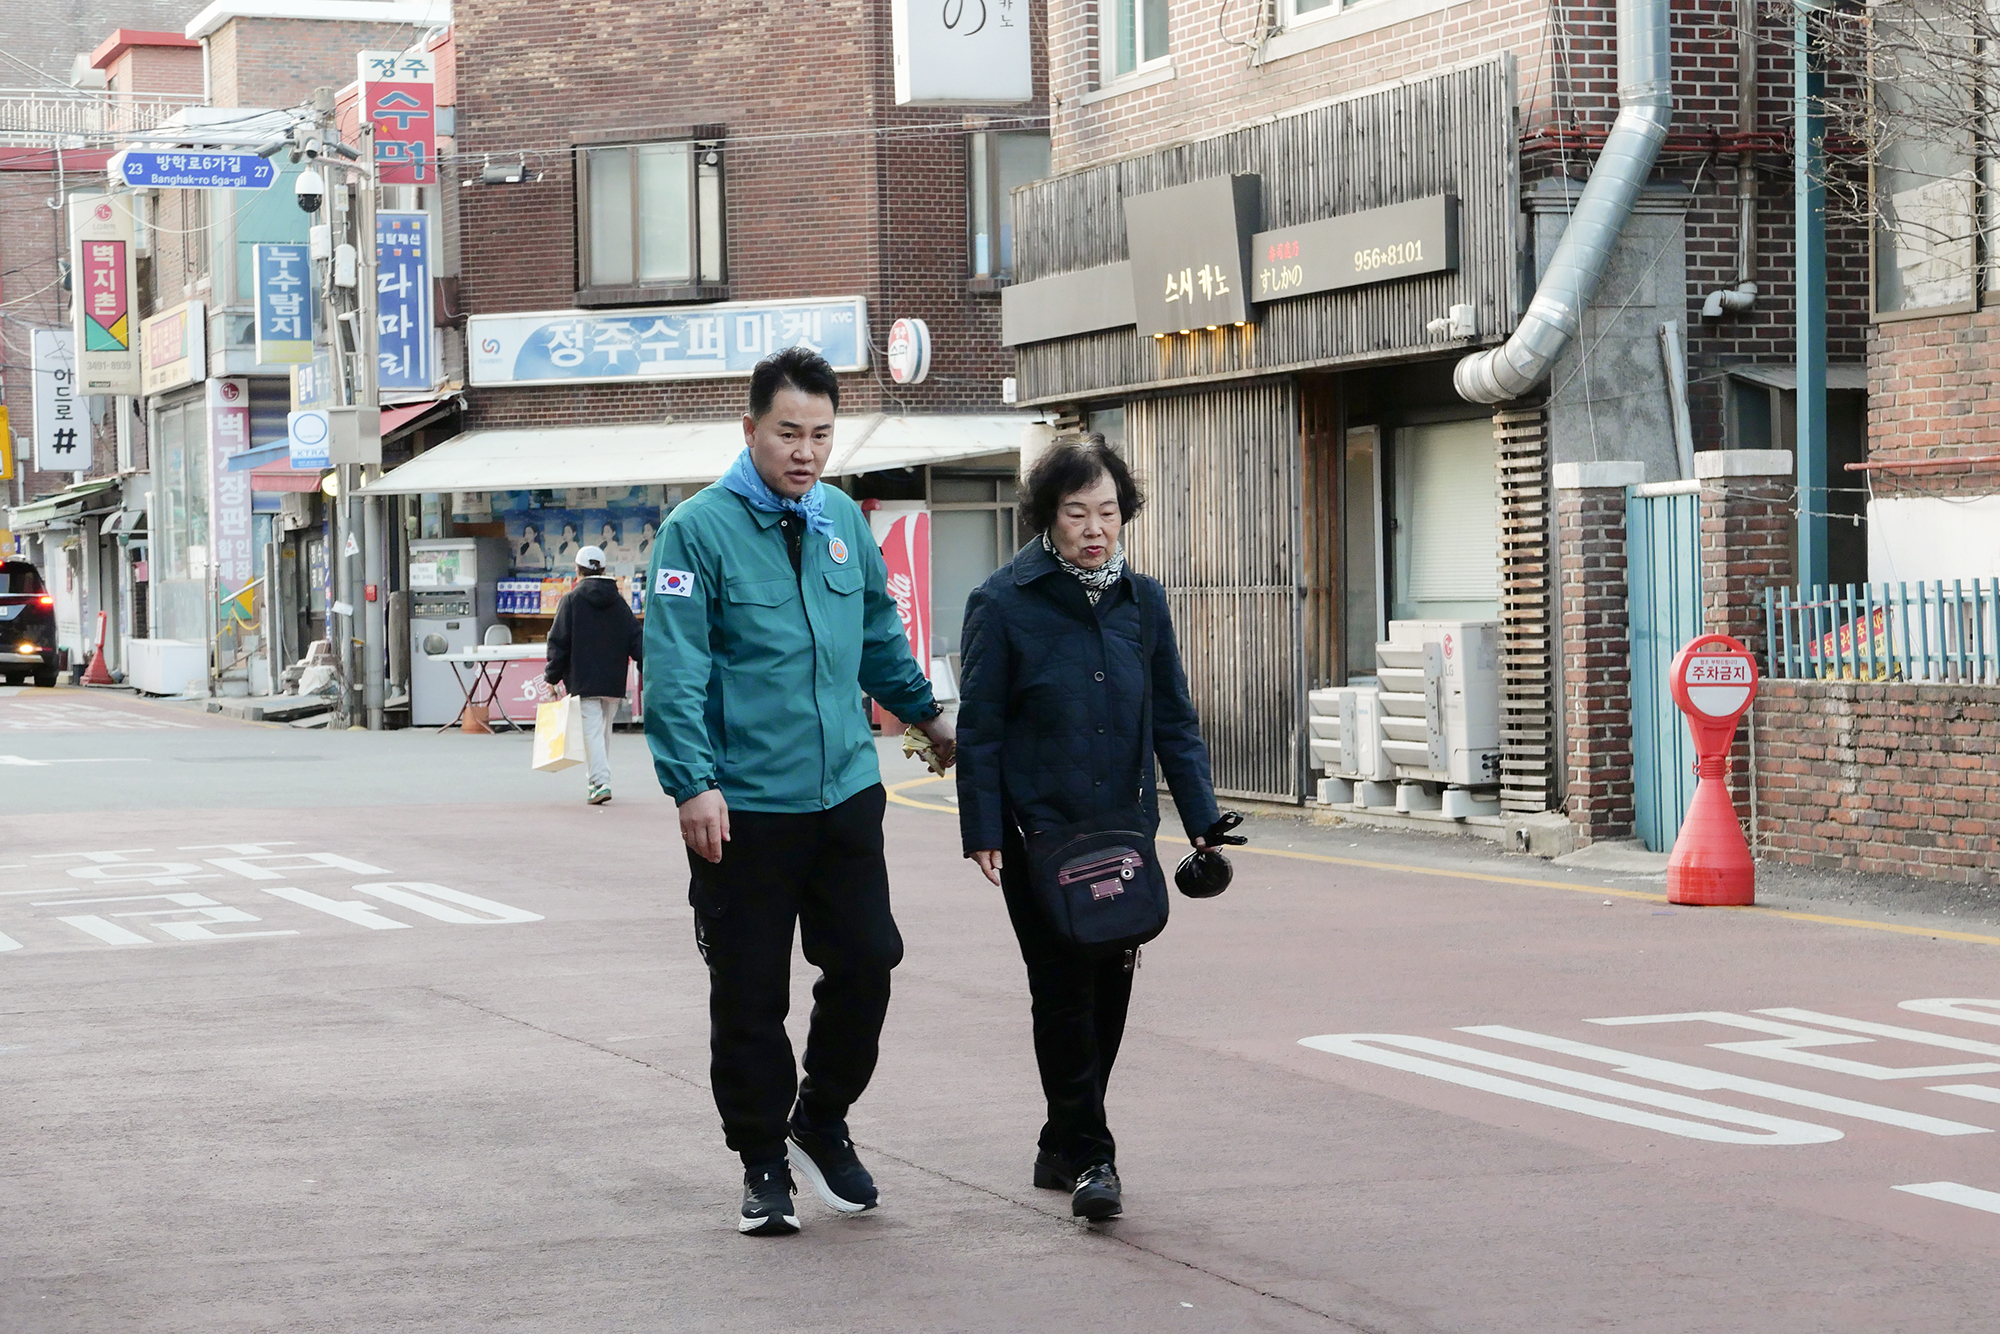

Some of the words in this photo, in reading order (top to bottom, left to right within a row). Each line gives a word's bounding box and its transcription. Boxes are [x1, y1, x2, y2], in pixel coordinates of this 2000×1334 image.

[369, 58, 429, 78] 정주
[373, 90, 429, 181] 수퍼
[127, 163, 143, 175] 23
[156, 155, 242, 173] 방학로6가길
[254, 166, 269, 178] 27
[151, 174, 209, 185] Banghak-ro
[211, 175, 247, 187] 6ga-gil
[92, 245, 117, 316] 벽지촌
[1259, 264, 1303, 295] すしかの
[267, 246, 304, 339] 누수탐지
[830, 311, 853, 324] KVC
[218, 538, 251, 559] 할인
[1444, 663, 1454, 677] LG
[1692, 665, 1746, 681] 주차금지
